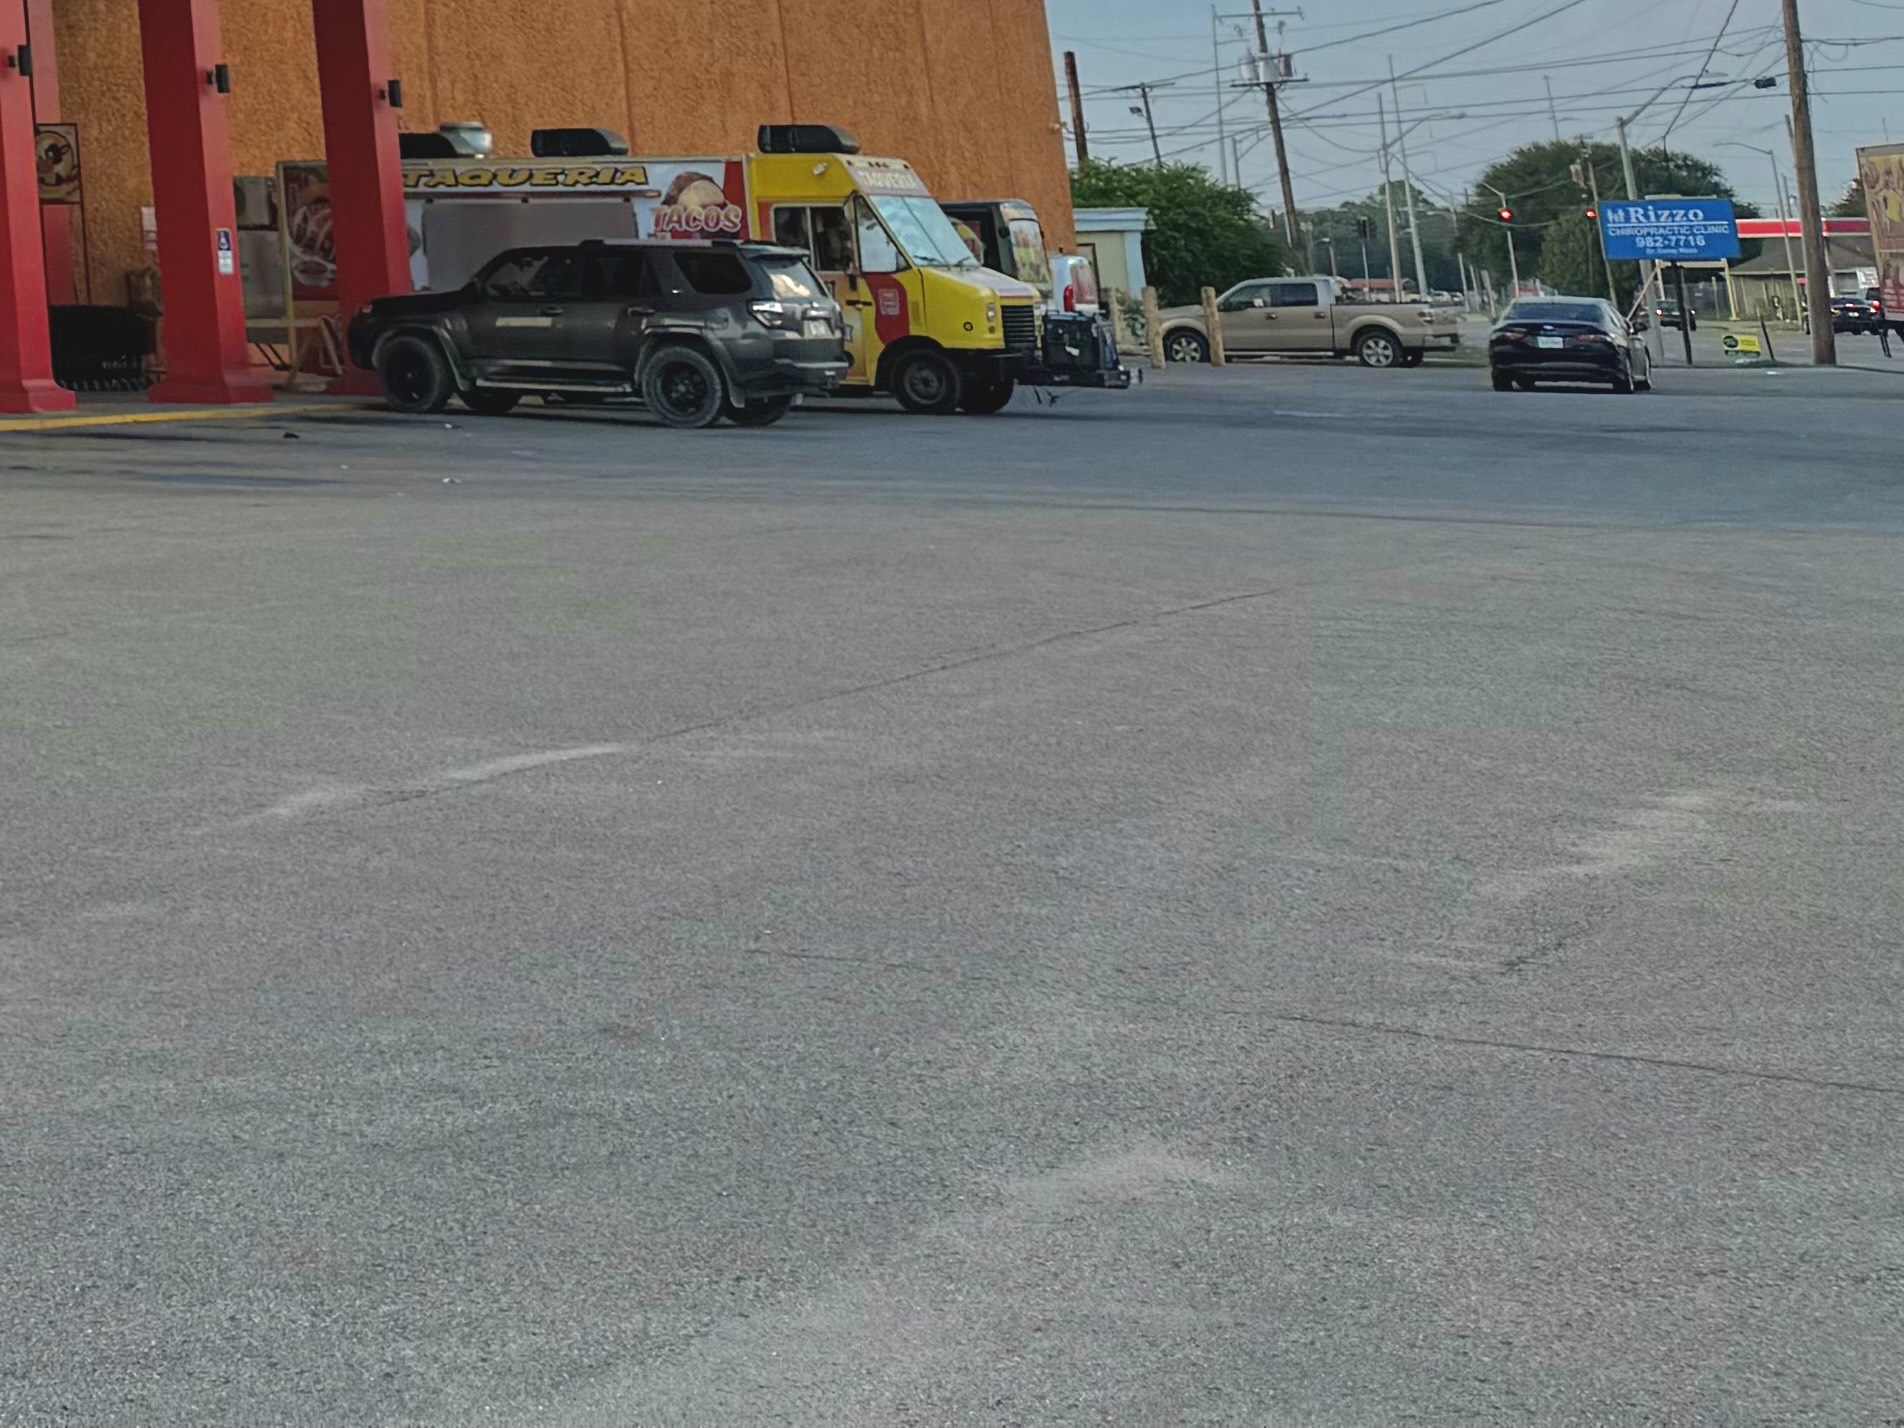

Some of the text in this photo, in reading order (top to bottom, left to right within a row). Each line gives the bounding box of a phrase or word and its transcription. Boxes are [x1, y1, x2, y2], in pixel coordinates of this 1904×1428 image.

[403, 165, 650, 189] TAQUERIA
[653, 204, 742, 233] TACOS
[1627, 204, 1704, 223] Rizzo
[1608, 224, 1730, 237] CHIROPRACTIC CLINIC
